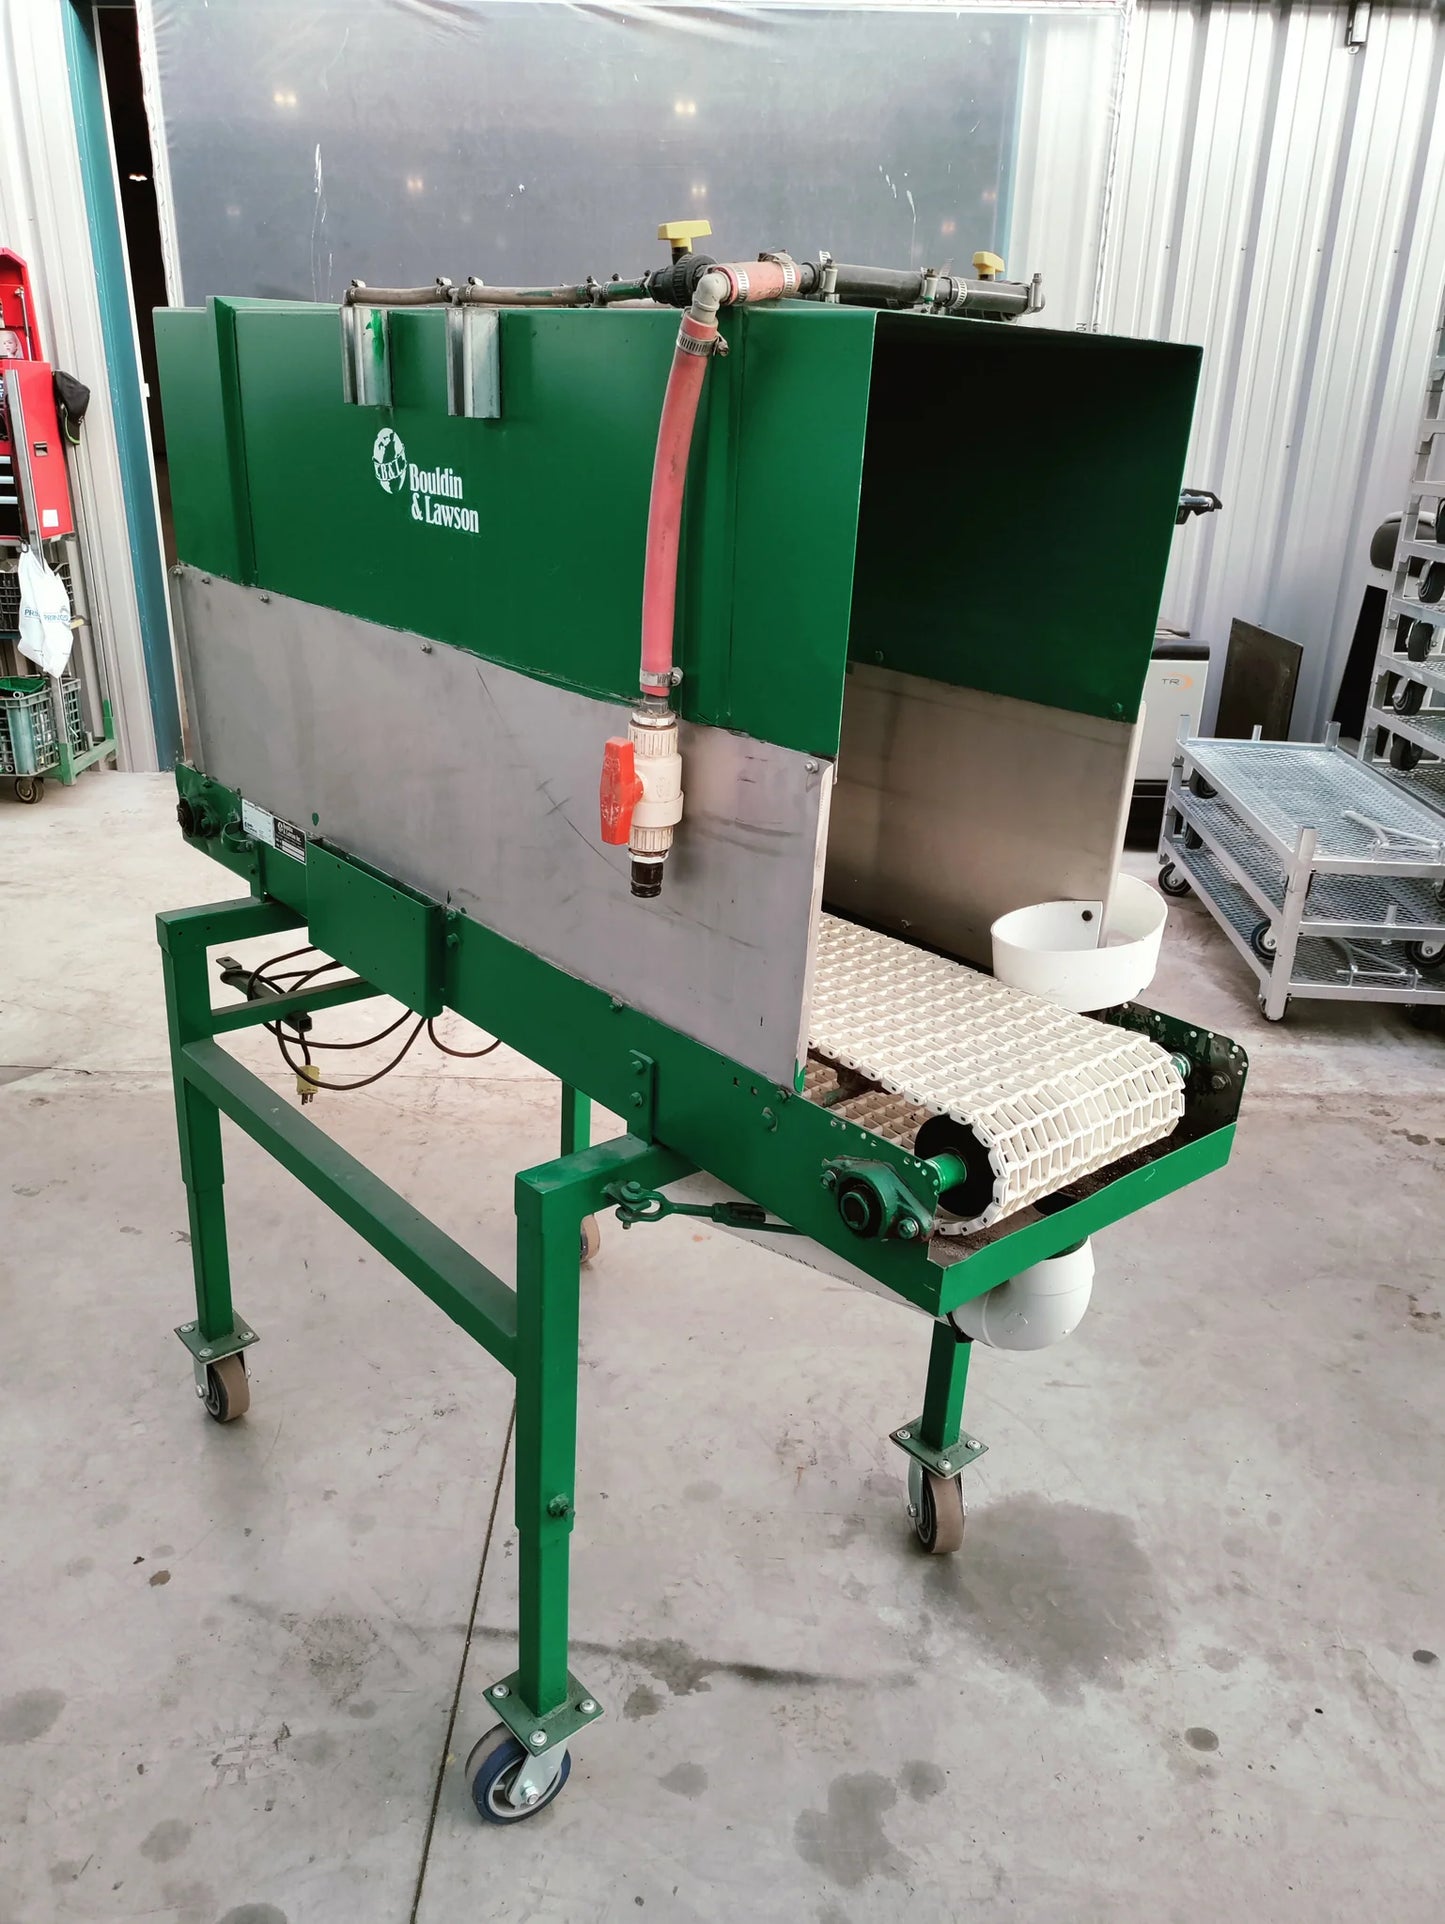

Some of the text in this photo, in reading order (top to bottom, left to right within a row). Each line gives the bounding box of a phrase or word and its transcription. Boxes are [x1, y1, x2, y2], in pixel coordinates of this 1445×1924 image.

[380, 459, 404, 481] B&L
[409, 463, 463, 499] Bouldin
[411, 492, 480, 533] & Lawson
[1161, 678, 1180, 686] TR
